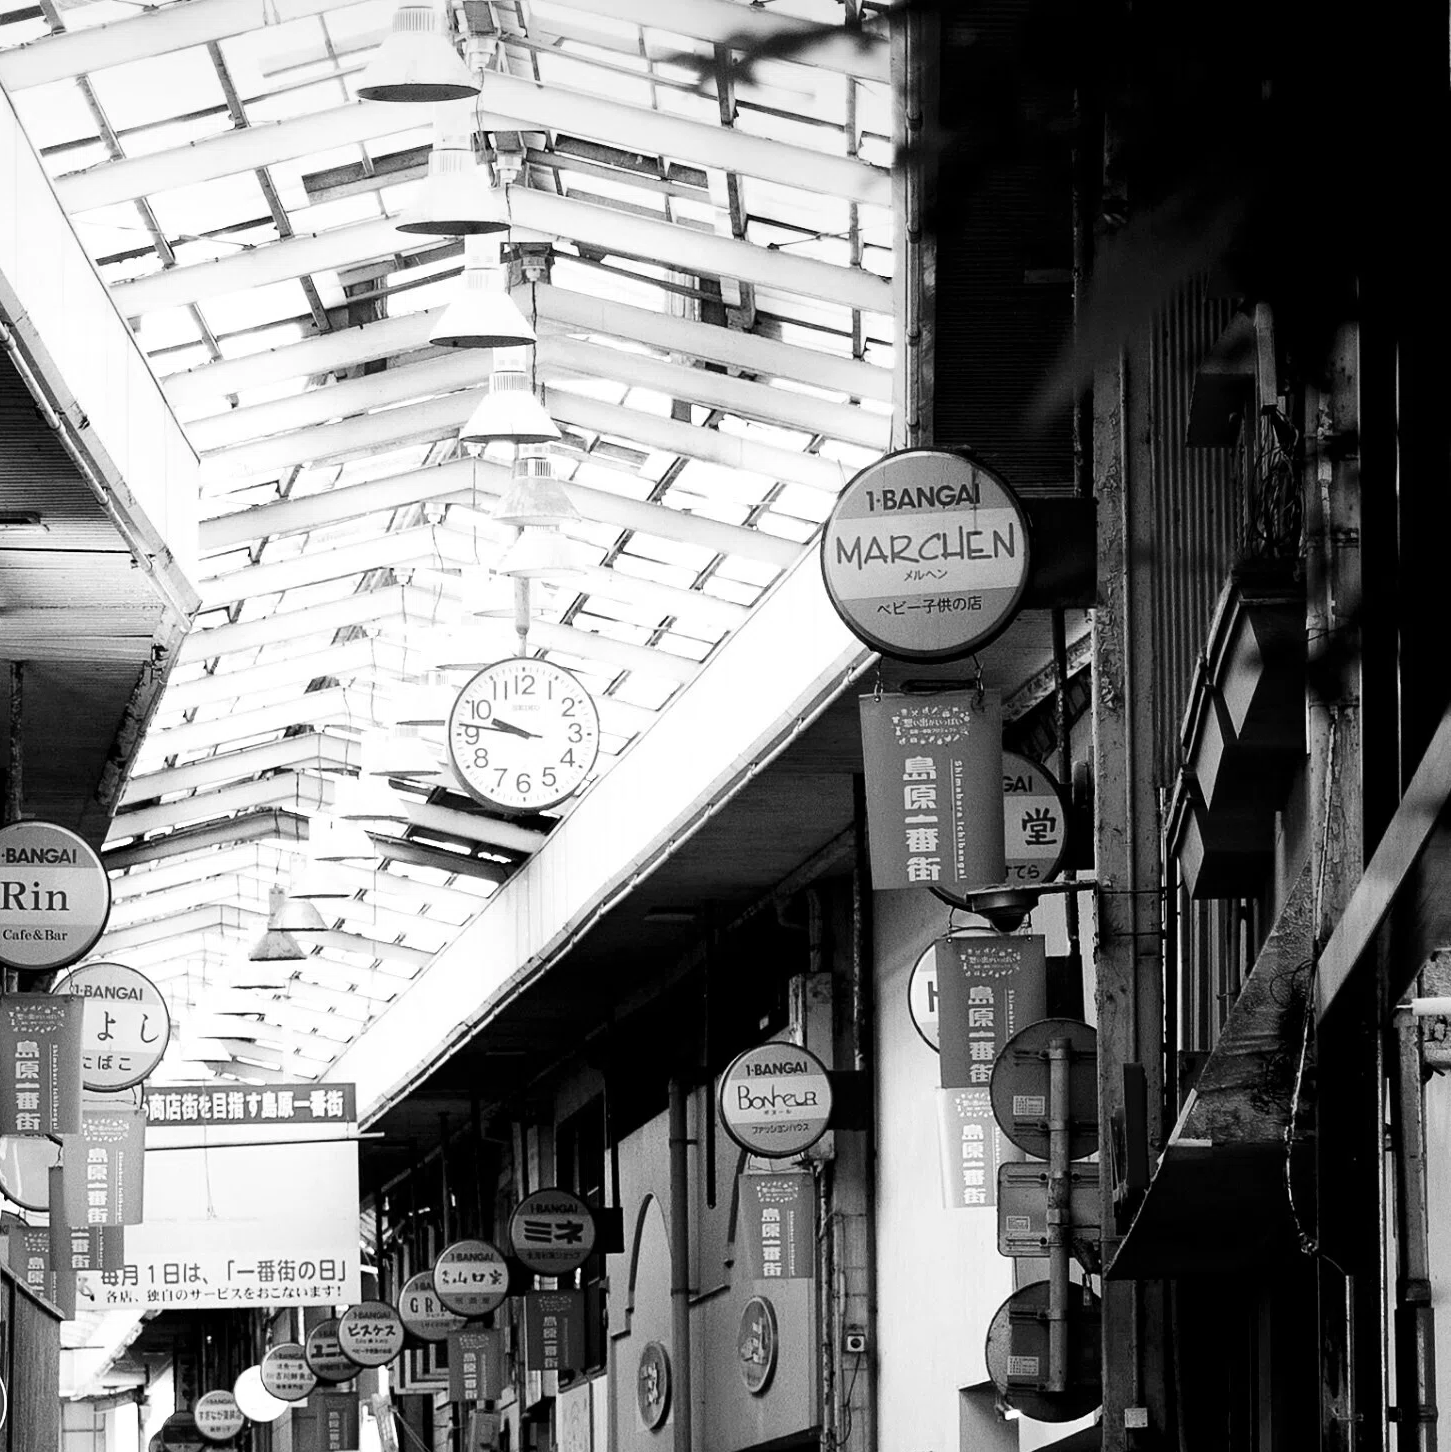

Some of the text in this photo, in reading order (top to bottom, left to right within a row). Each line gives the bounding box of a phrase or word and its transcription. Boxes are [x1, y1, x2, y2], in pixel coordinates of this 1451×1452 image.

[836, 522, 1015, 570] MARCHEN
[904, 569, 948, 582] メルヘン
[877, 595, 982, 616] ベビー子供の店
[493, 680, 508, 700] 11
[515, 674, 535, 695] 12
[548, 680, 552, 700] 1
[471, 700, 492, 720] 10
[561, 697, 576, 717] 2
[464, 725, 480, 745] 9
[568, 723, 583, 743] 3
[474, 748, 489, 769] 8
[560, 748, 576, 768] 4
[493, 768, 508, 787] 7
[516, 773, 531, 793] 6
[542, 767, 557, 787] 5
[903, 756, 942, 881] 島原一番街
[954, 760, 967, 880] Shimabara Ichibangai
[1022, 807, 1057, 846] 堂
[0, 881, 70, 911] Rin
[2, 929, 68, 941] Cafe&Bar
[968, 985, 995, 1083] 島原一番街
[15, 1040, 41, 1131] 島原一番街
[144, 1090, 343, 1121] 商店街を目指す島原一番街
[752, 1123, 809, 1135] ファッションハウス
[962, 1123, 987, 1205] 島原一番街
[524, 1220, 584, 1245] ミネ
